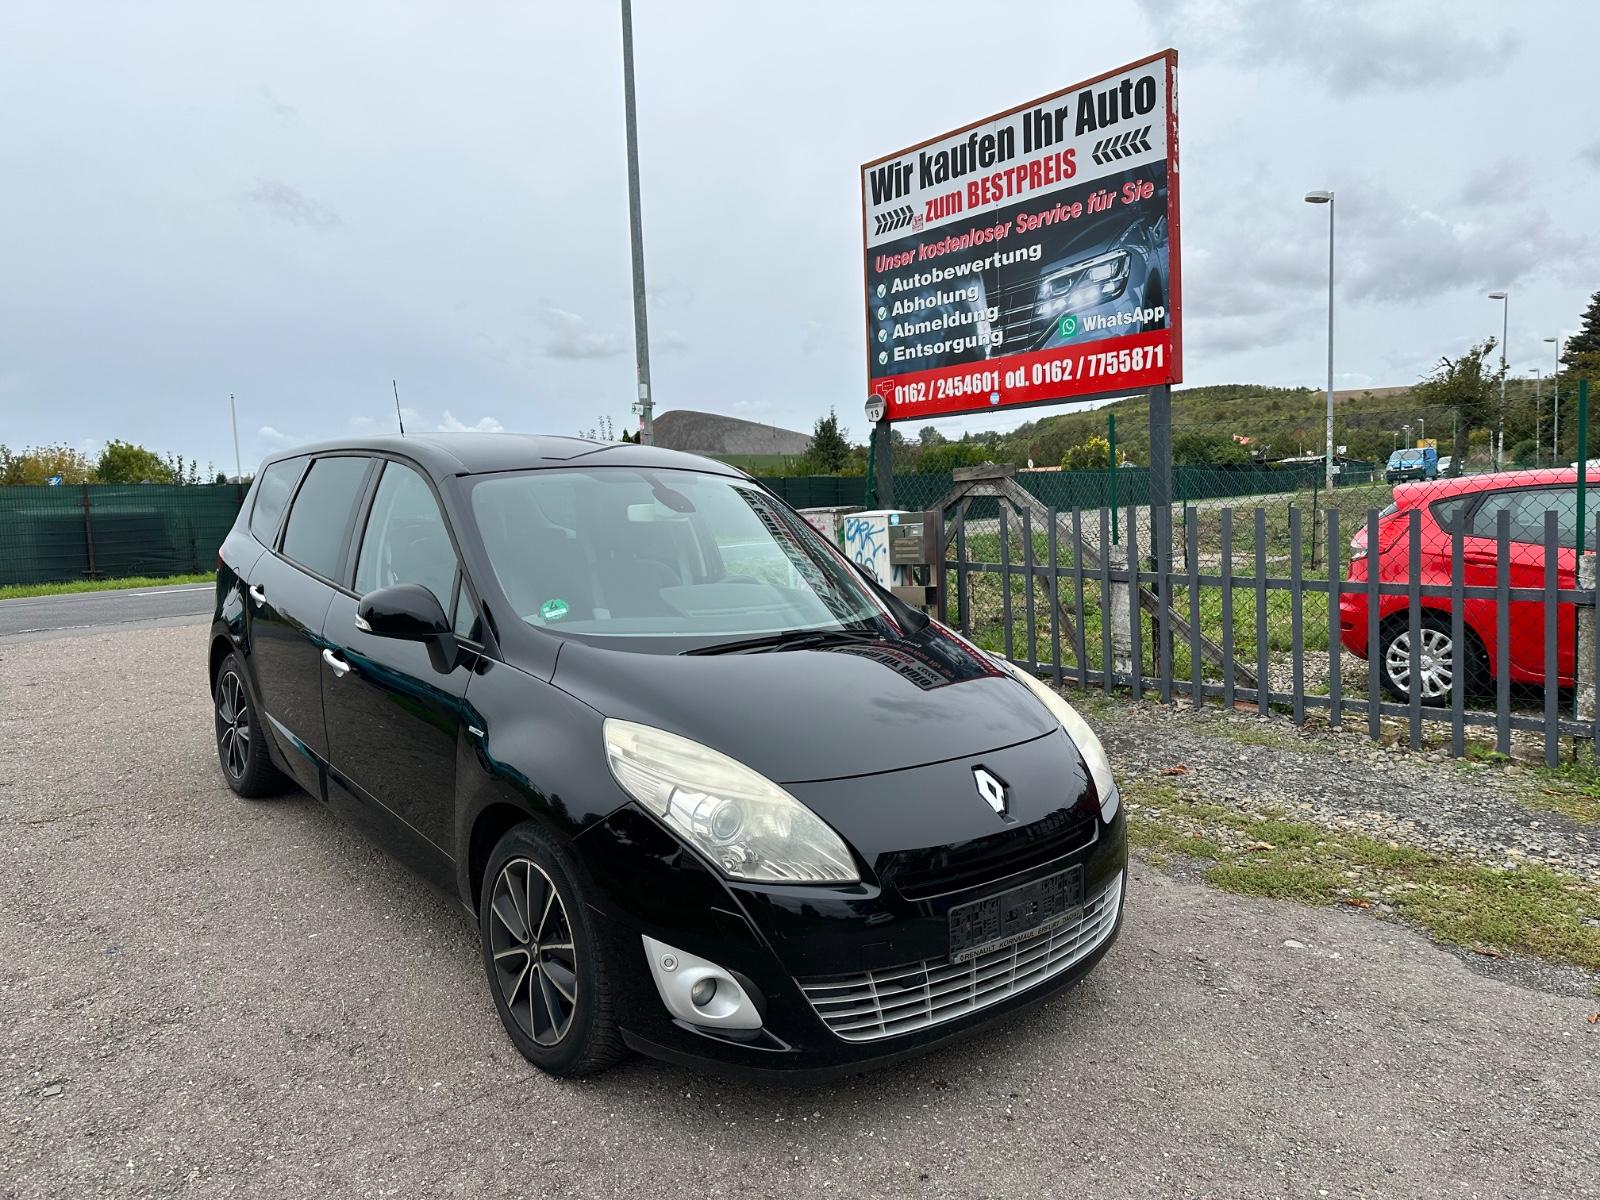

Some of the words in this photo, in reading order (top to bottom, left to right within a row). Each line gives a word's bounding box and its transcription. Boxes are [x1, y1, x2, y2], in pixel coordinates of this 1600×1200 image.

[870, 160, 914, 206] Wir
[918, 124, 1015, 190] kaufen
[1022, 105, 1068, 155] Ihr
[1075, 75, 1157, 137] Auto
[925, 189, 963, 224] zum
[966, 147, 1077, 209] BESTPREIS
[875, 249, 916, 273] Unser
[918, 220, 1012, 262] kostenloser
[1015, 201, 1083, 234] Service
[1087, 189, 1117, 214] für
[1120, 179, 1155, 205] Sie
[890, 243, 1042, 294] Autobewertung
[891, 285, 979, 317] Abholung
[892, 305, 1000, 339] Abmeldung
[1083, 304, 1165, 332] WhatsApp
[893, 329, 1004, 362] Entsorgung
[894, 382, 926, 405] 0162
[928, 380, 935, 401] /
[937, 369, 1000, 397] 2454601
[1005, 366, 1030, 389] od.
[1032, 357, 1073, 384] 0162
[1075, 355, 1083, 379] /
[1088, 343, 1164, 377] 7755871
[964, 944, 996, 962] RENAULT
